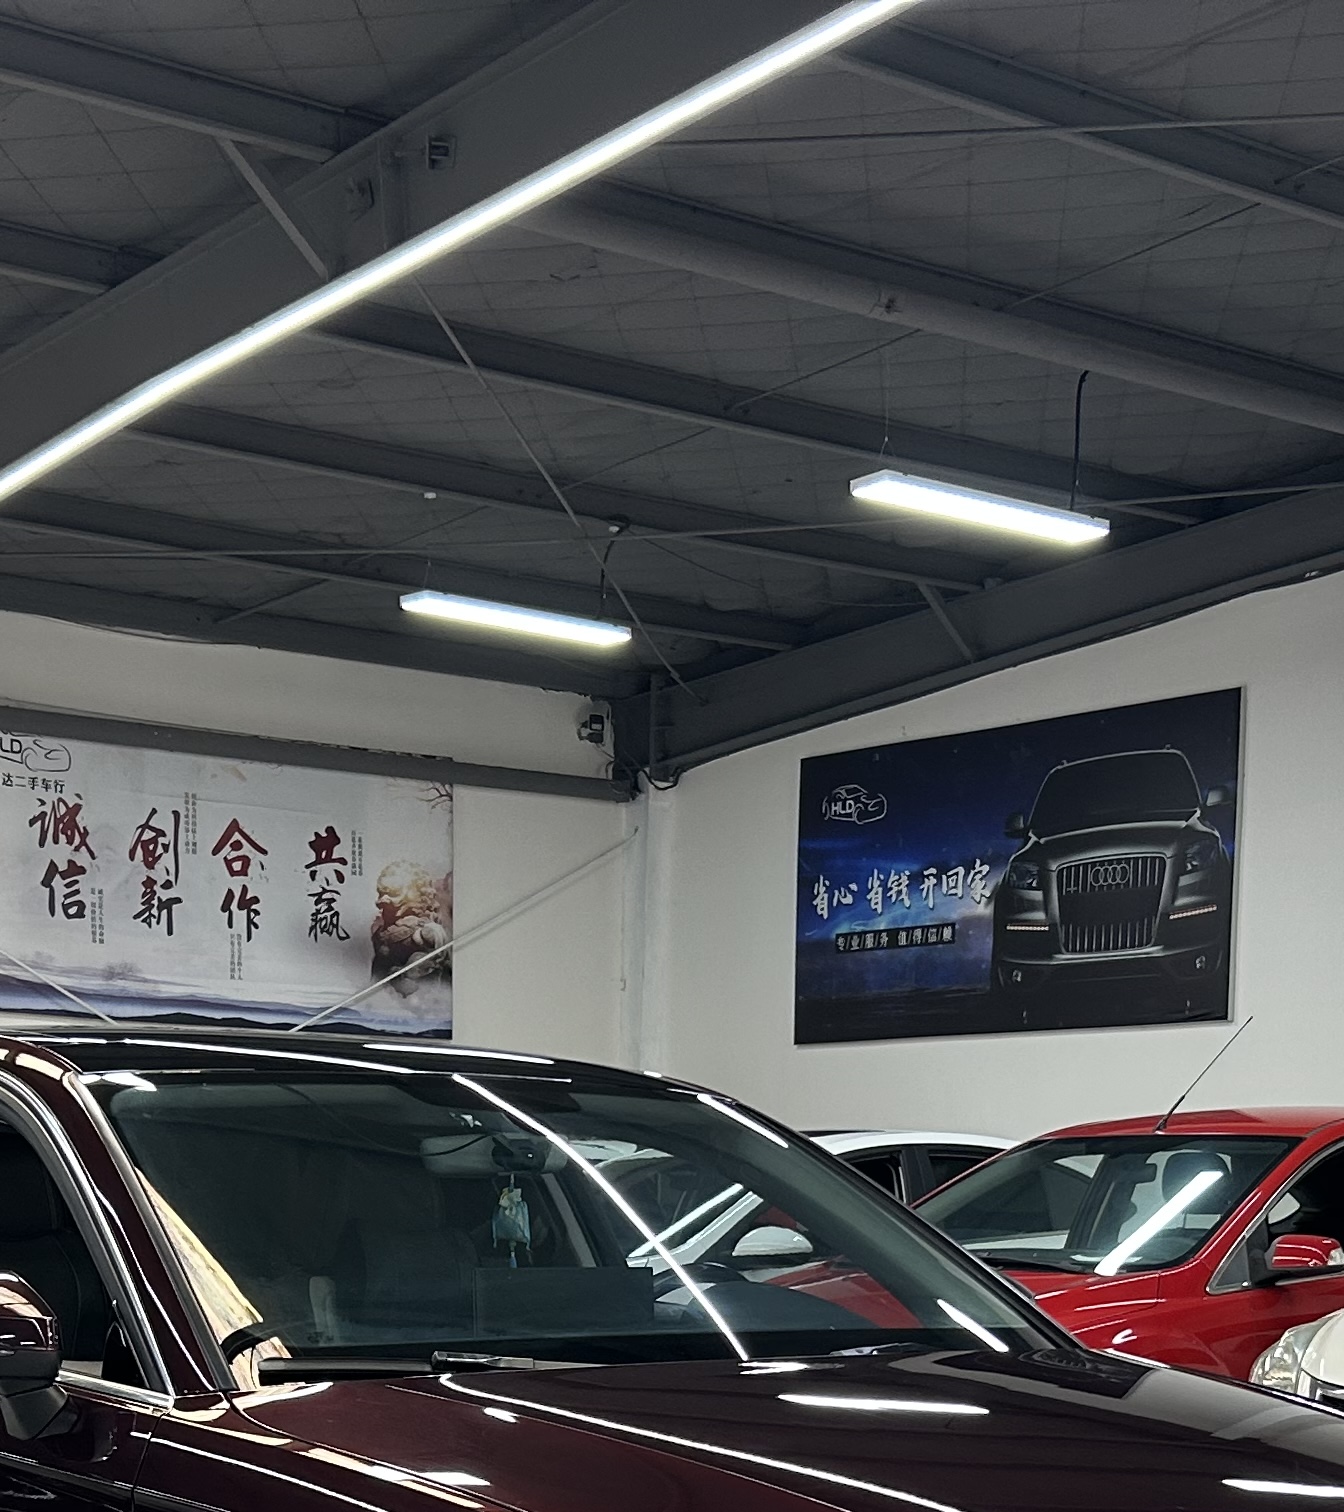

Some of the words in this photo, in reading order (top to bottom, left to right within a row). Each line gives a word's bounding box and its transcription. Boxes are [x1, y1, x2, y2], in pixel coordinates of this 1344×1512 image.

[831, 799, 855, 816] HLD
[211, 818, 269, 943] 合作
[812, 874, 859, 920] 省心
[866, 867, 911, 915] 省钱
